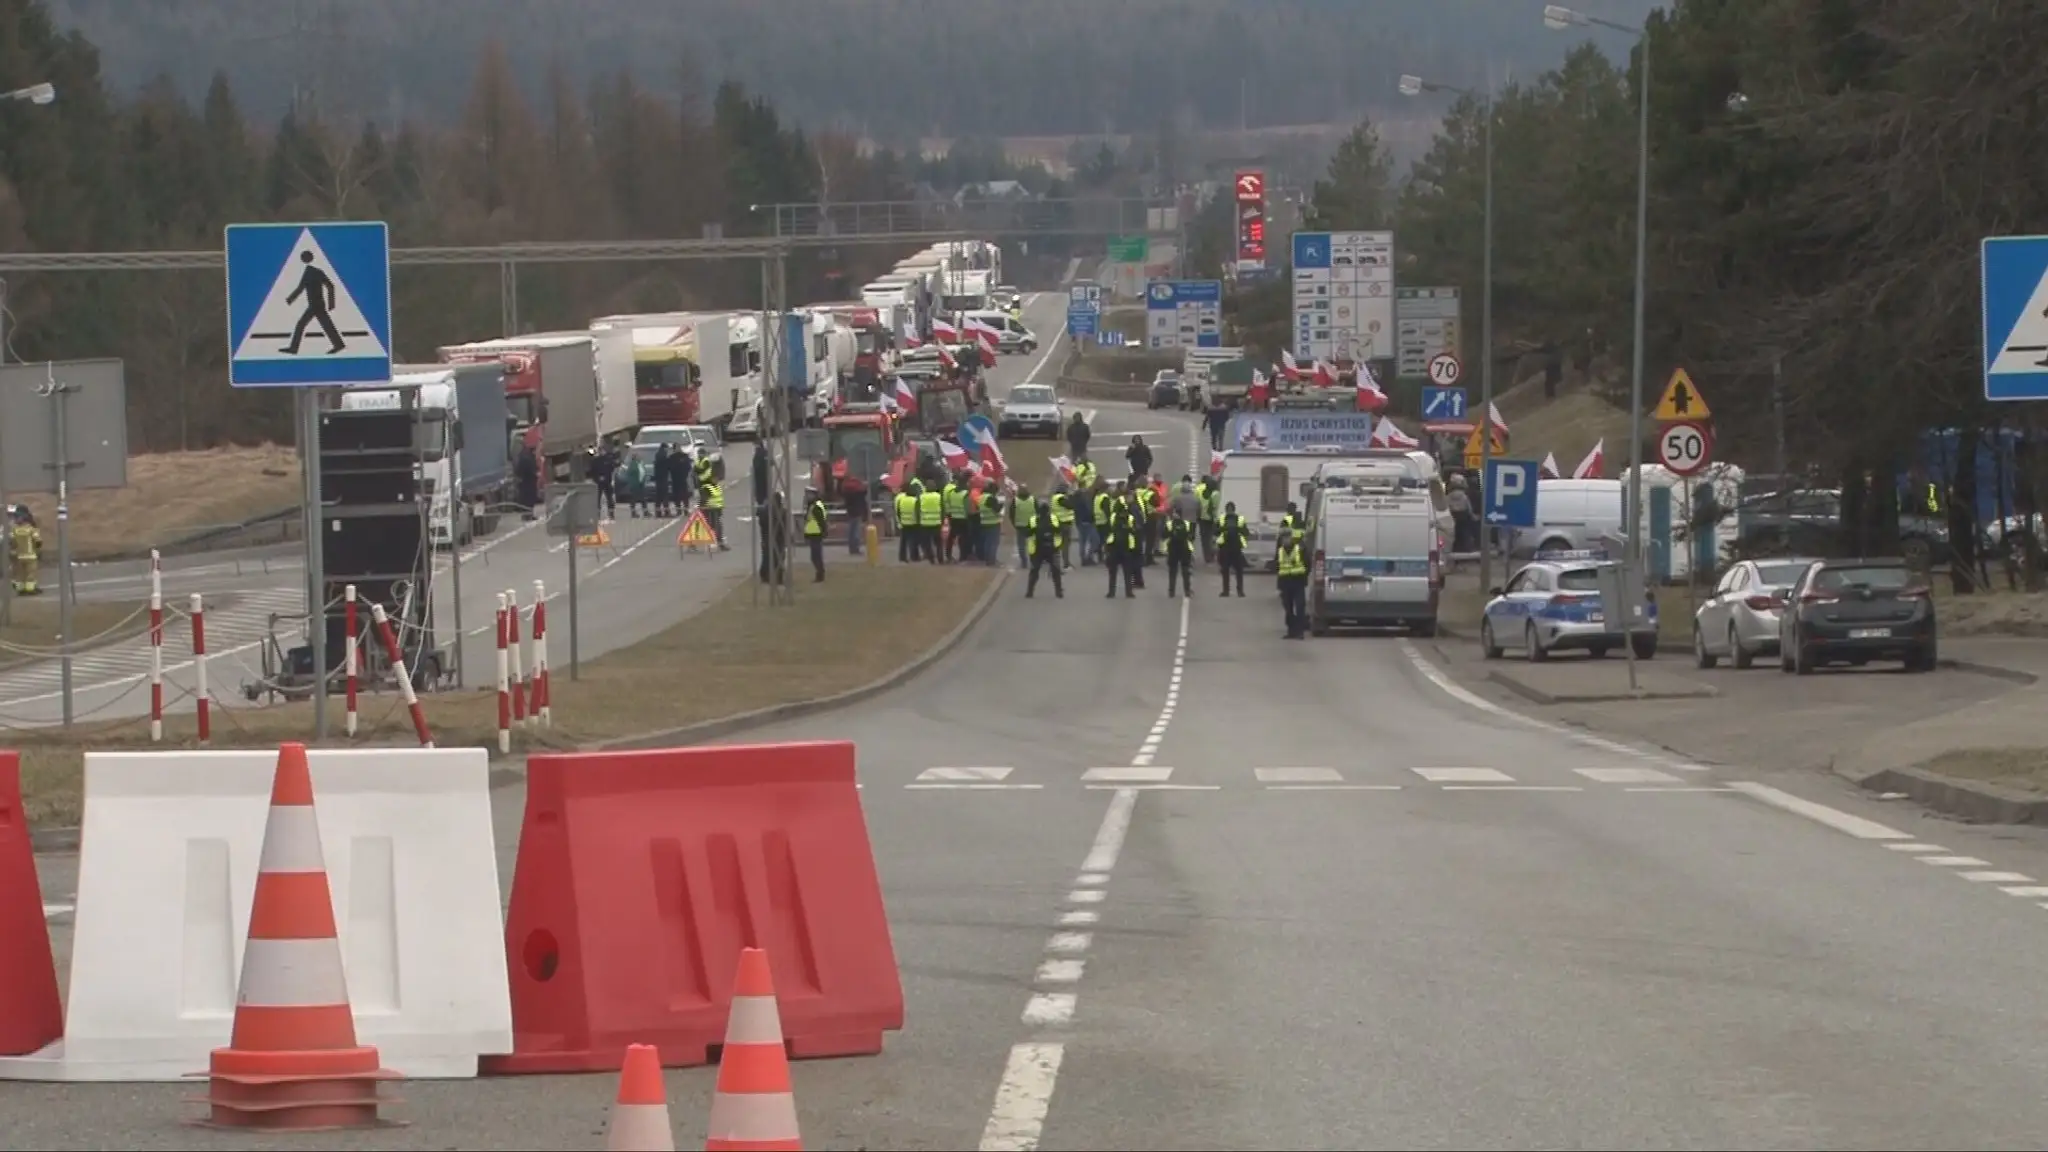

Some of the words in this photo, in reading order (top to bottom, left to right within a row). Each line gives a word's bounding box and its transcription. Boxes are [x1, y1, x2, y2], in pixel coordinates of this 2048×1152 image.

[1434, 361, 1457, 378] 70
[1667, 435, 1702, 461] 50
[1495, 464, 1526, 507] P
